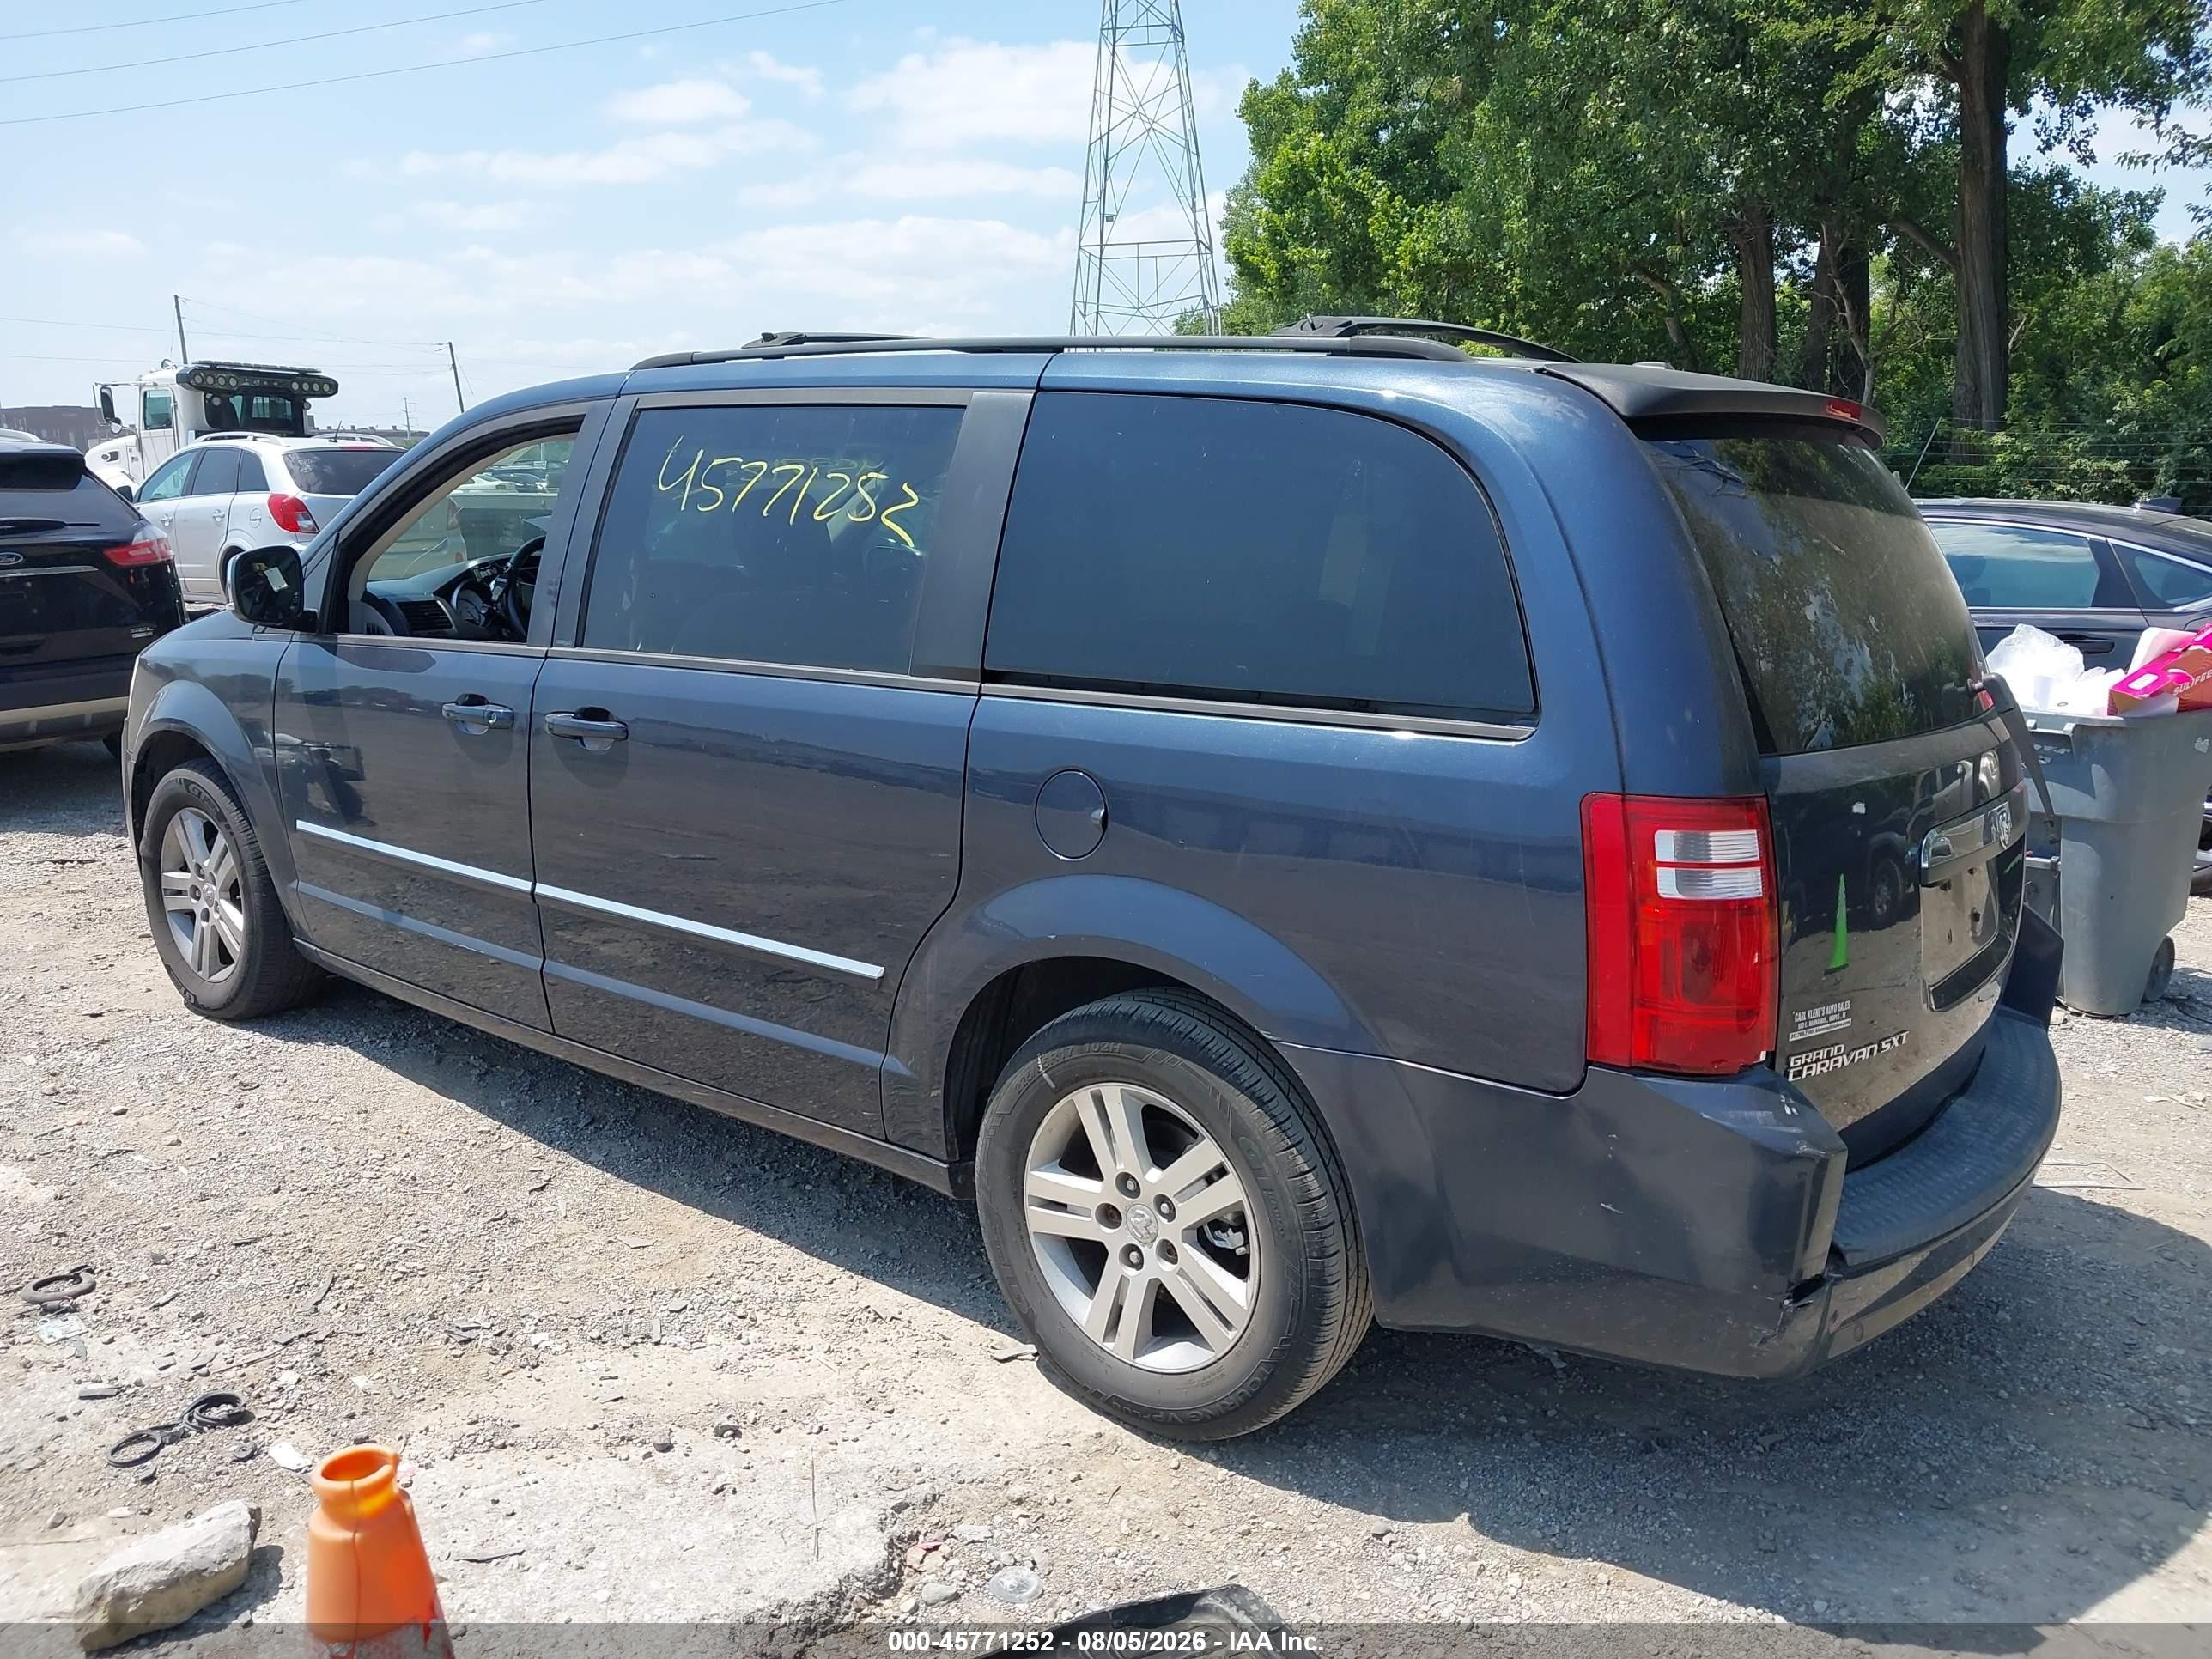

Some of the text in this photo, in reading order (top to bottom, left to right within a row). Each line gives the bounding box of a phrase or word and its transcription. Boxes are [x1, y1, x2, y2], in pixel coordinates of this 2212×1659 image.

[1794, 1011, 1807, 1023] CARL
[1826, 1002, 1838, 1015] AUTO
[1838, 1000, 1850, 1012] SALES
[1084, 1041, 1121, 1054] 102H
[1787, 1030, 1910, 1082] CARAVAN SXT
[1789, 1043, 1844, 1067] GRAND
[1186, 1360, 1274, 1424] TOURING
